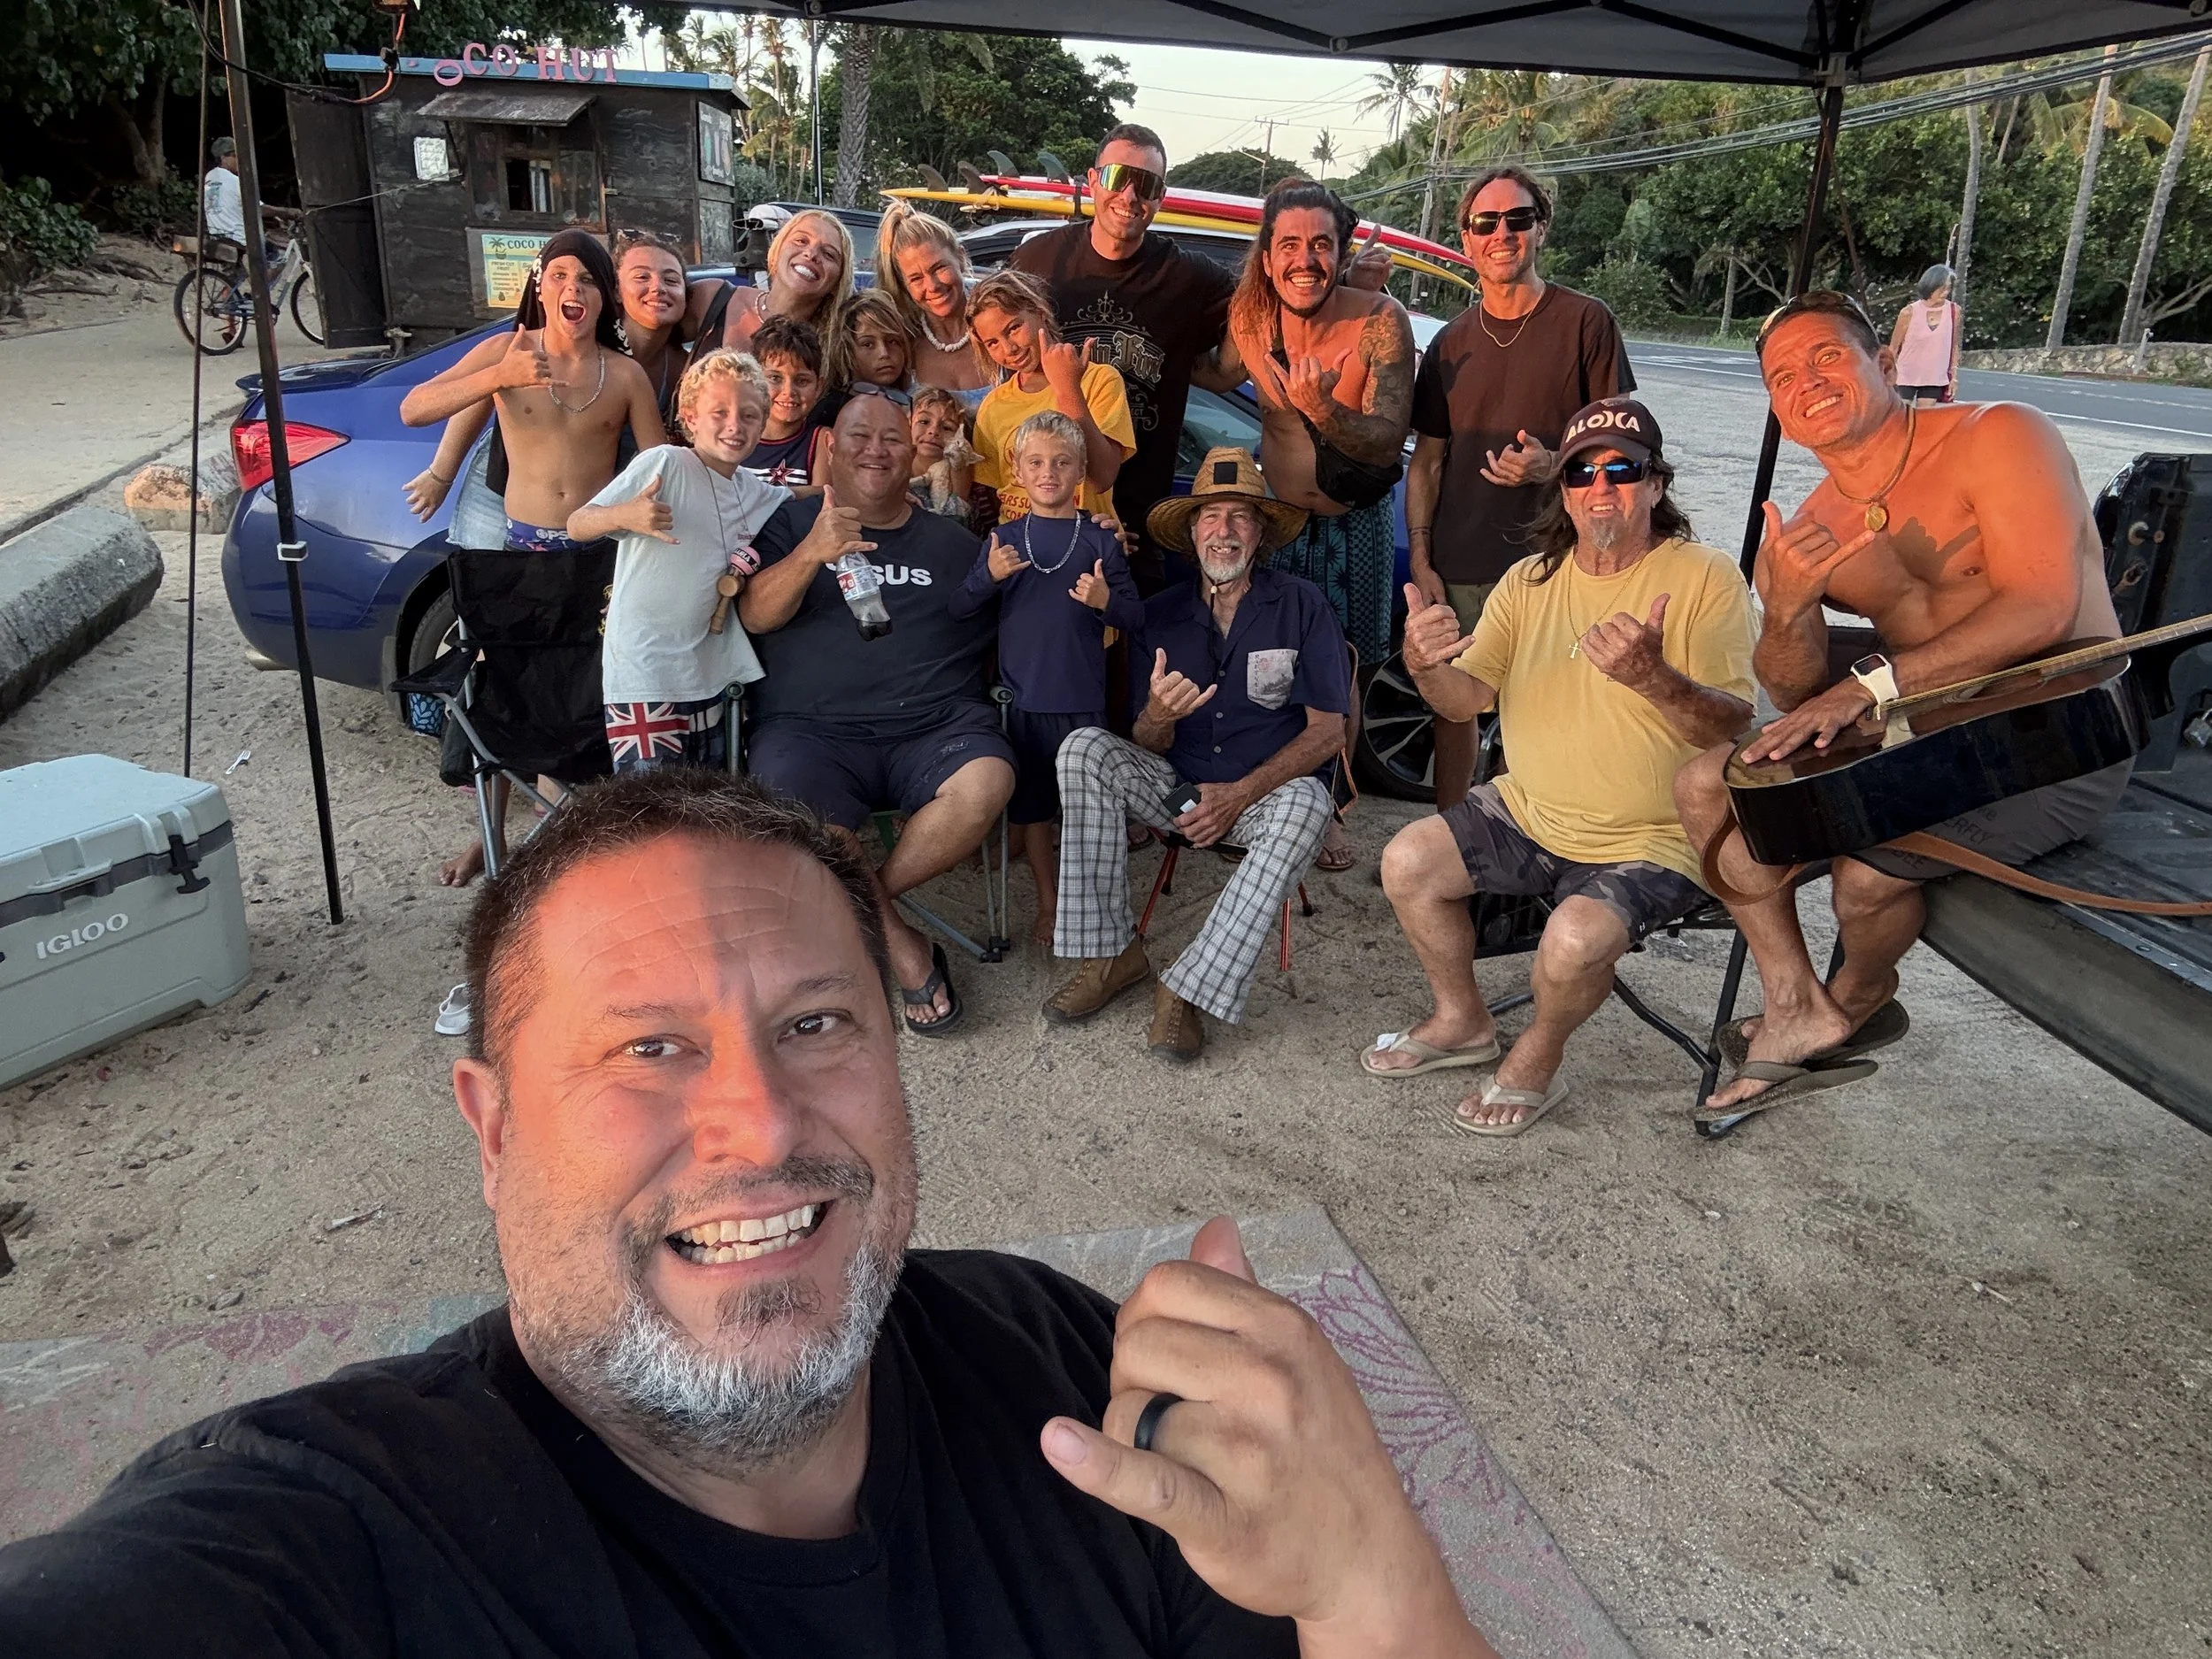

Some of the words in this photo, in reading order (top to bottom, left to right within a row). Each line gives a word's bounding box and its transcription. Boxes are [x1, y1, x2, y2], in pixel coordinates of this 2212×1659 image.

[535, 46, 618, 83] HUT
[507, 240, 535, 250] COCO
[36, 913, 129, 960] IGLOO
